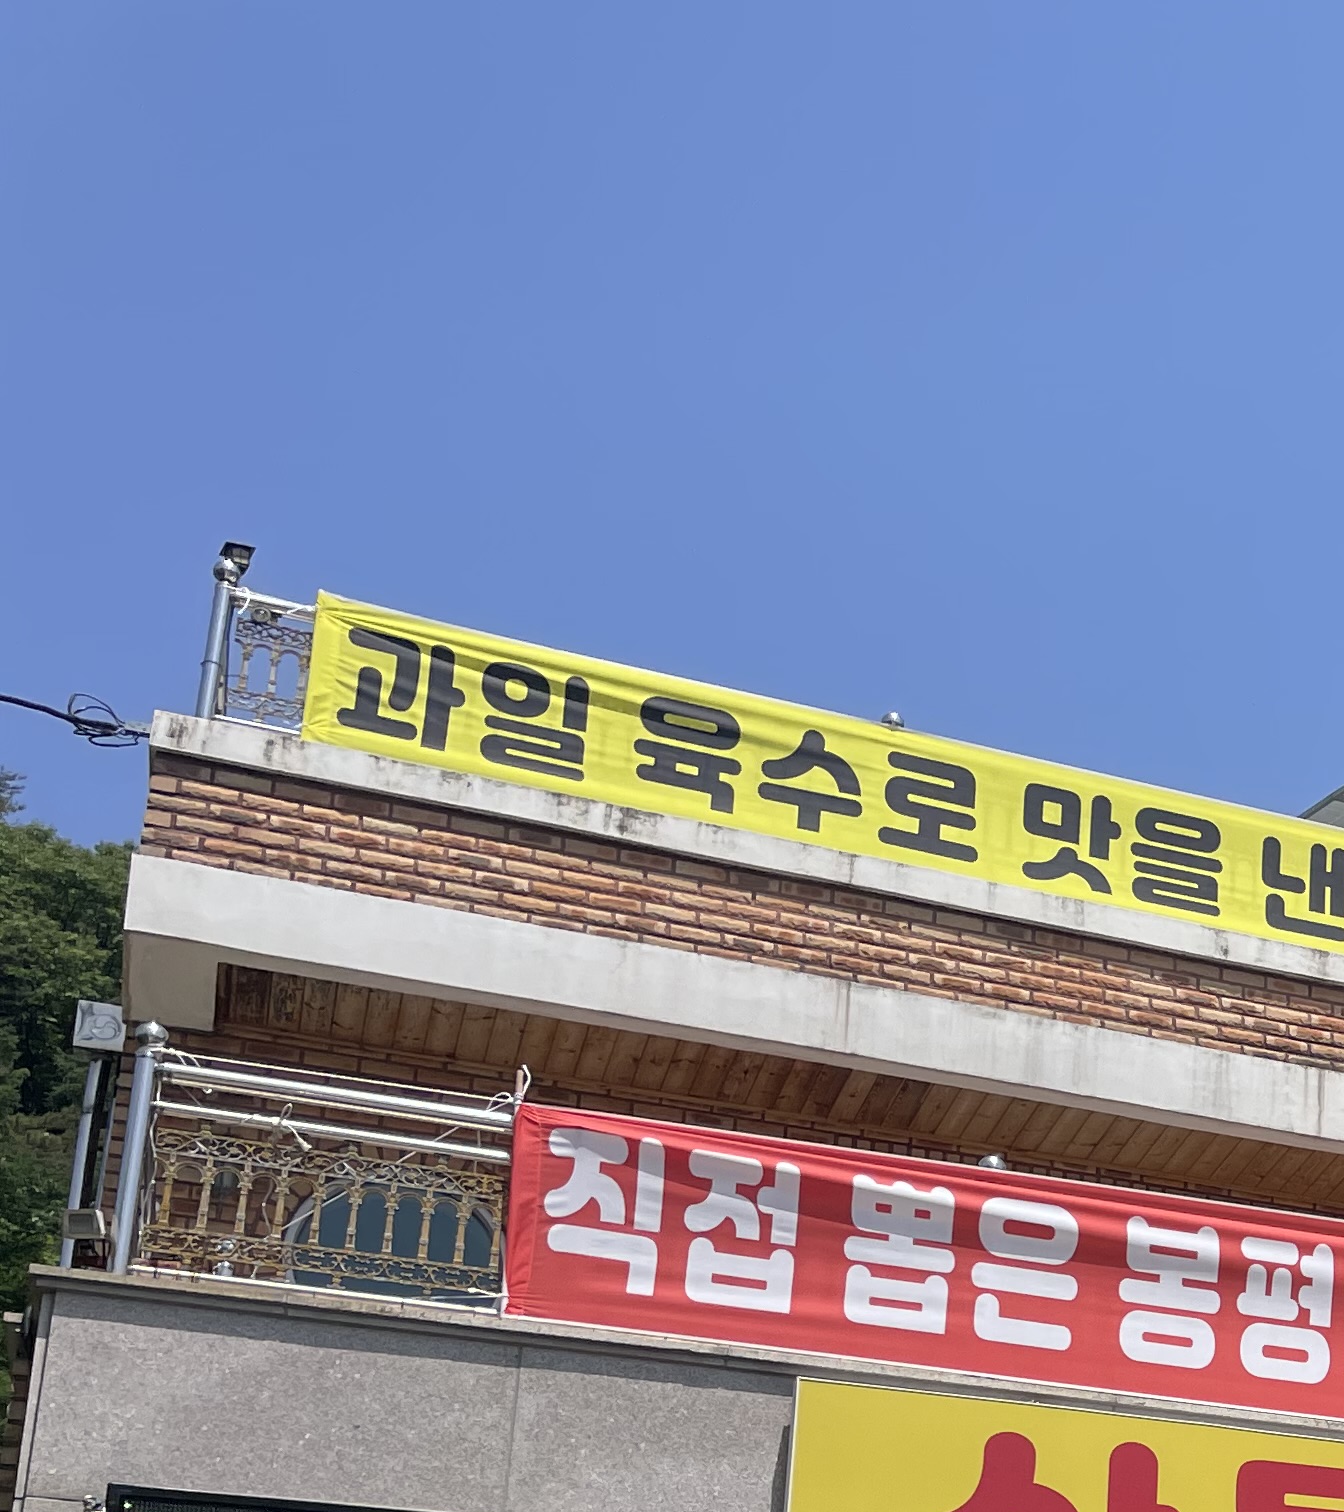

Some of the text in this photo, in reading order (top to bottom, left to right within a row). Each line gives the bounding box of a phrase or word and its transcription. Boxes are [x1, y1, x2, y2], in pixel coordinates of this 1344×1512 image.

[337, 627, 590, 780] 과일
[634, 696, 978, 862] 육수로
[1023, 784, 1222, 916] 맛을
[544, 1128, 801, 1314] 직접
[844, 1174, 1079, 1351] 뽑은
[1118, 1216, 1335, 1386] 봉평
